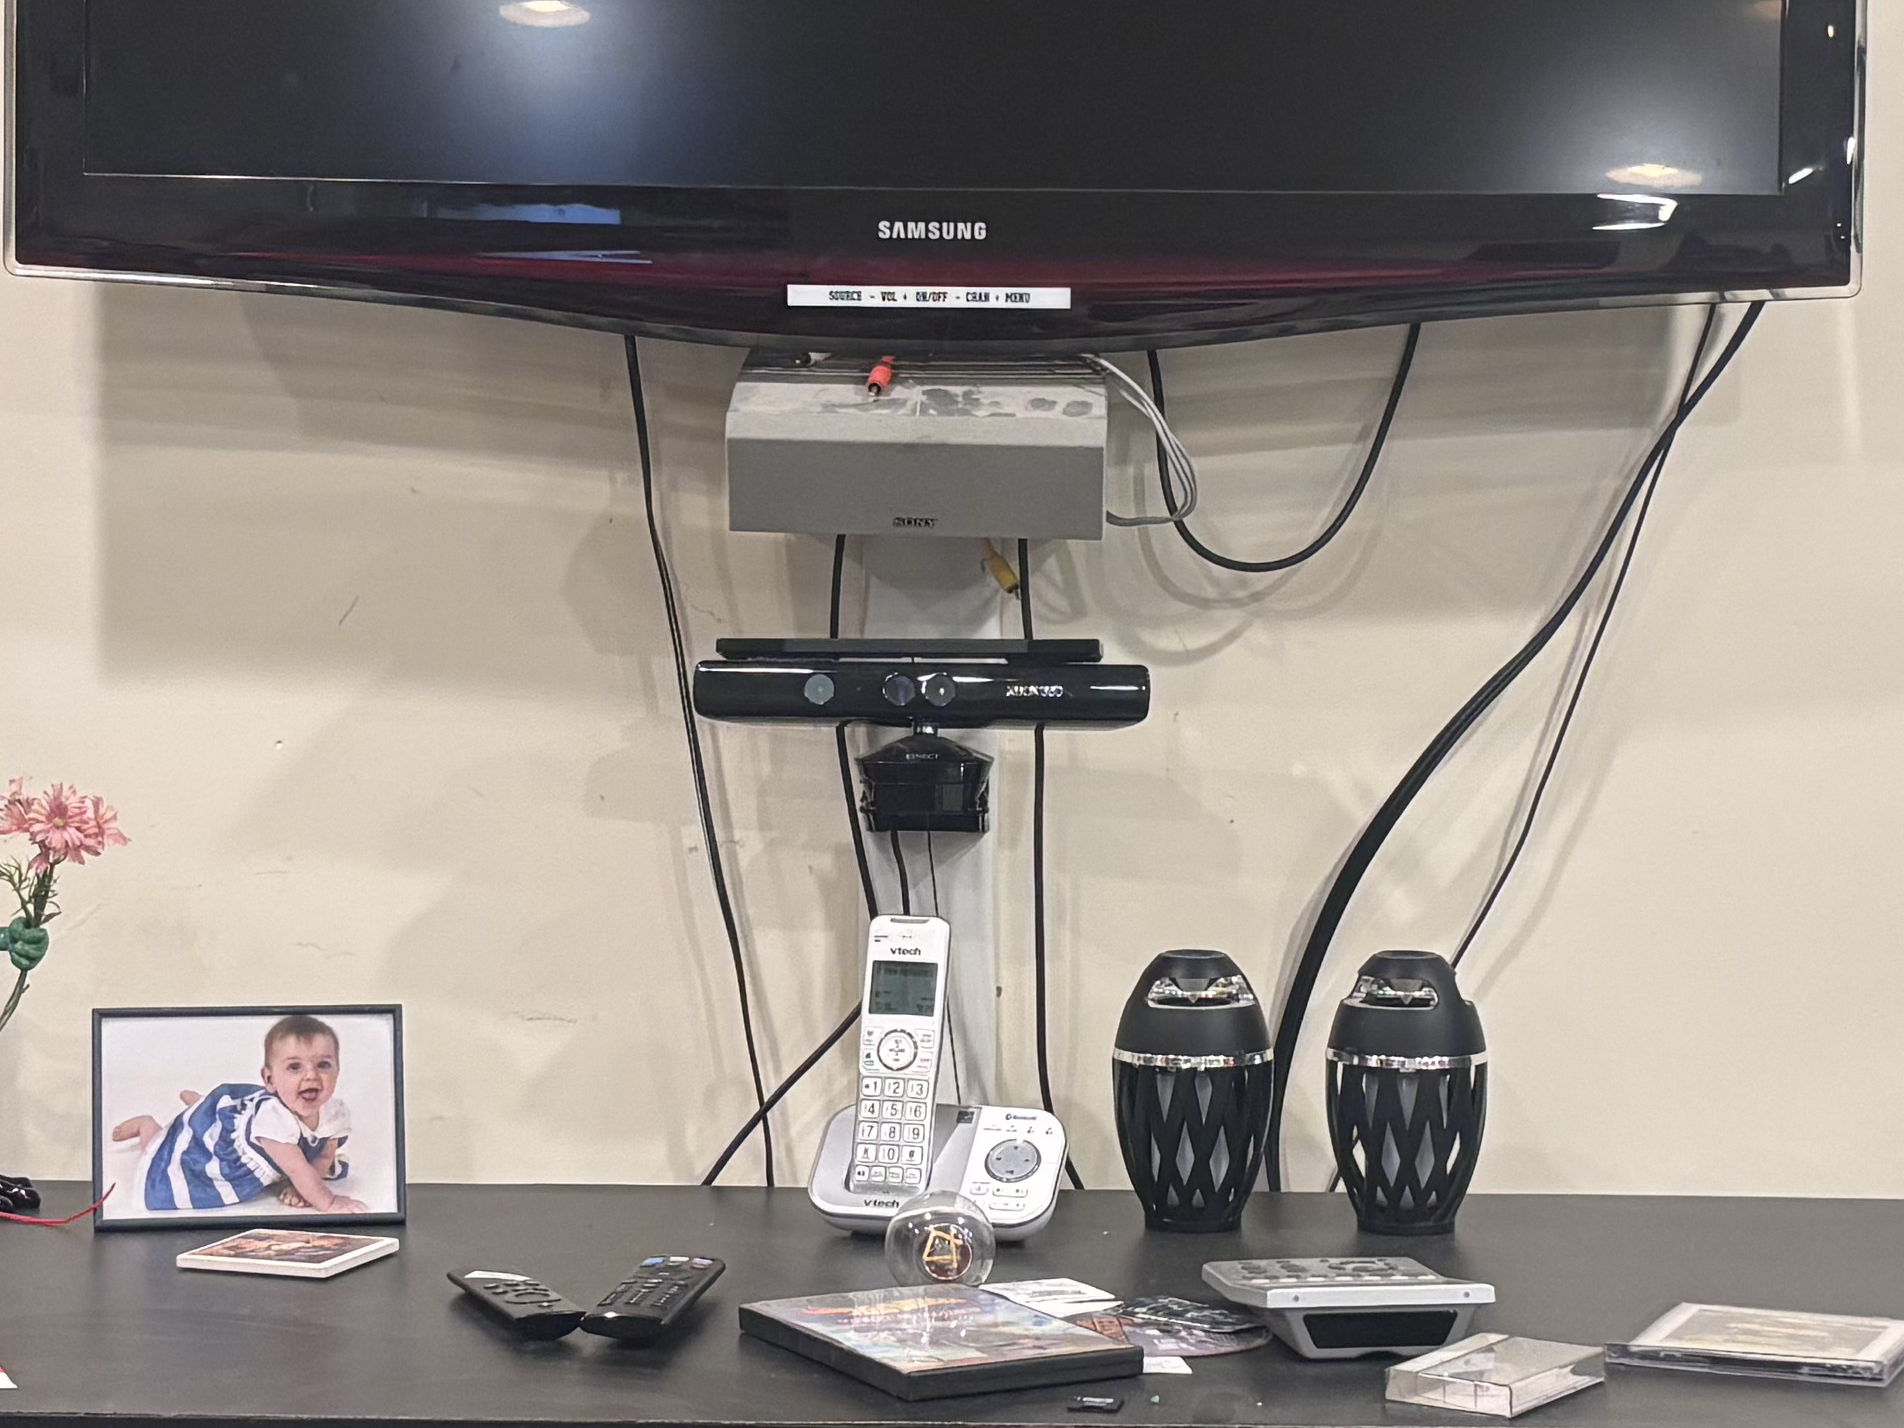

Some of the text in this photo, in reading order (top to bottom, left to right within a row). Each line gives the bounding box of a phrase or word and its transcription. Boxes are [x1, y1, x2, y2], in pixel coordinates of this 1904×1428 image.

[878, 221, 987, 239] SAMSUNG
[829, 291, 862, 300] SOURCE
[881, 292, 897, 302] VOL
[916, 292, 947, 302] ON/OFF
[966, 293, 989, 302] CHAN
[1005, 294, 1030, 303] MENU
[893, 517, 937, 527] SONY
[890, 947, 921, 956] vtech
[864, 1199, 899, 1209] vtech
